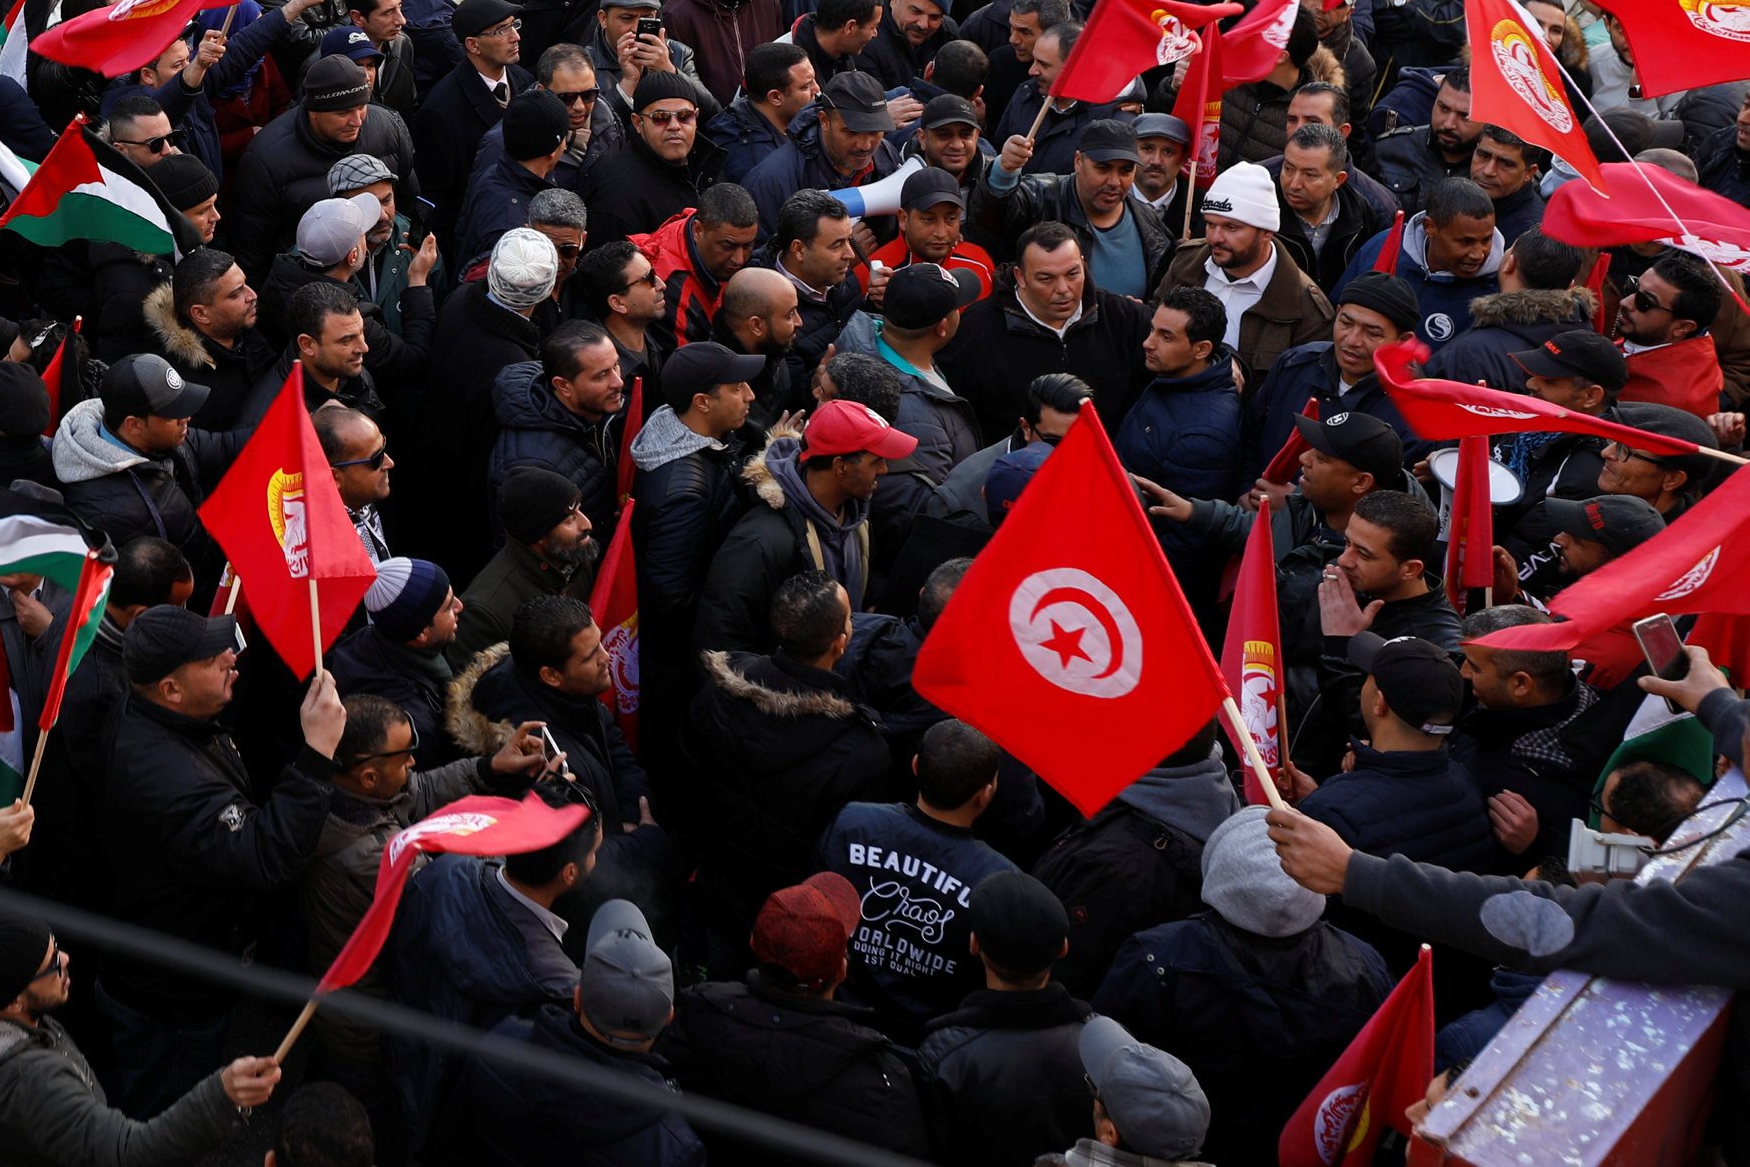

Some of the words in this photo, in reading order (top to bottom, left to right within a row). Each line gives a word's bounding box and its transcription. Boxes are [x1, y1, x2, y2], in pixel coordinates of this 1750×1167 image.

[313, 84, 365, 101] SALOMON
[849, 842, 971, 910] BEAUTIFU
[852, 926, 957, 976] ORLDWIDE
[854, 941, 886, 958] DOING
[890, 950, 900, 964] IT
[904, 956, 936, 976] RIGHT
[864, 952, 884, 968] 1ST
